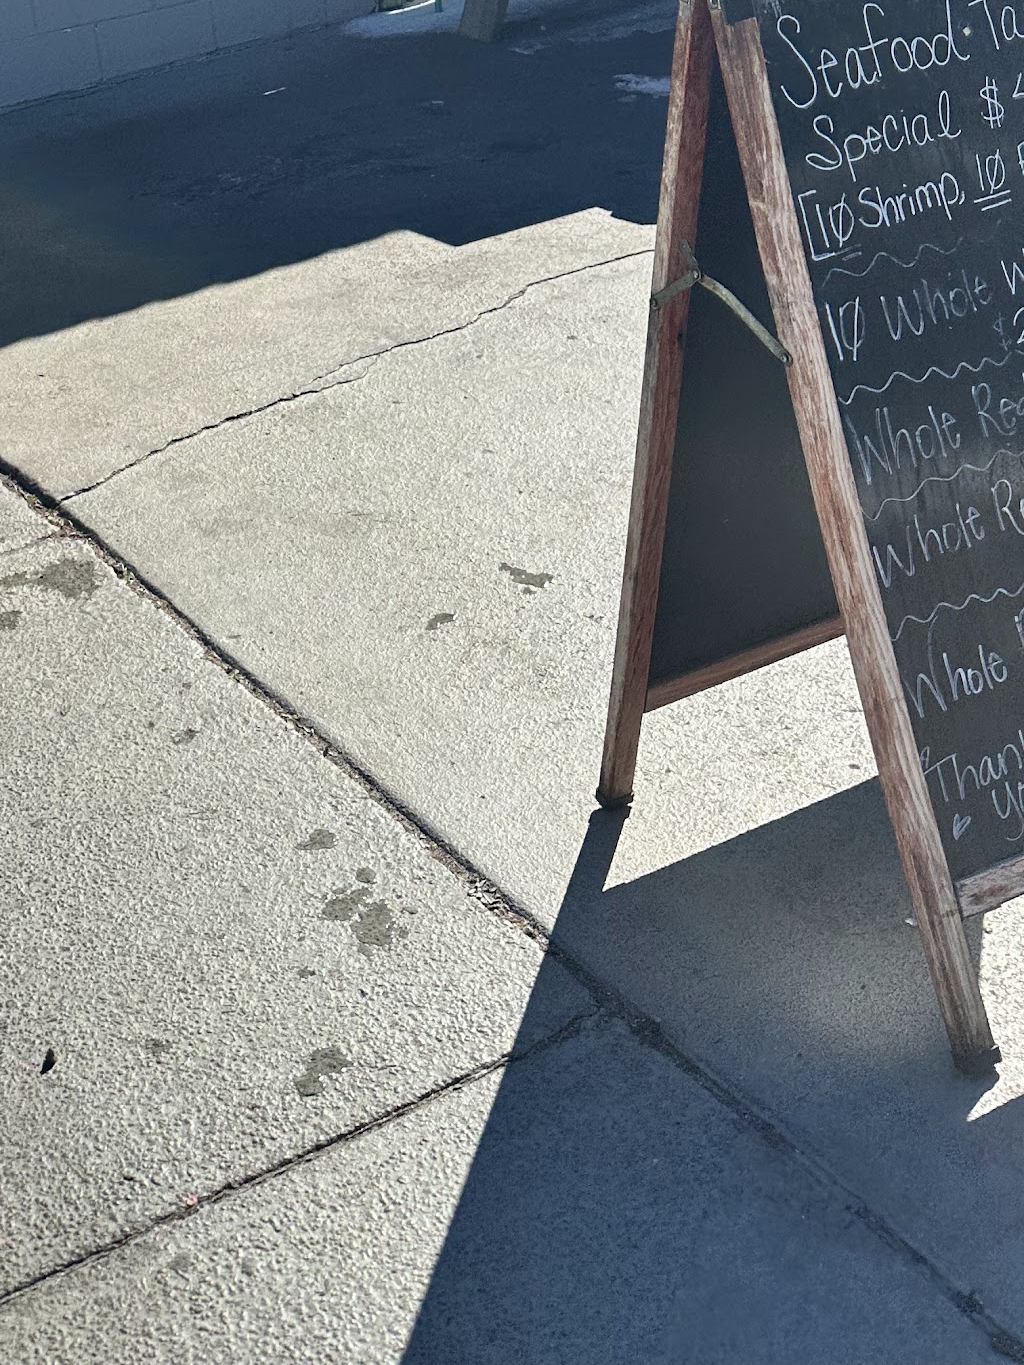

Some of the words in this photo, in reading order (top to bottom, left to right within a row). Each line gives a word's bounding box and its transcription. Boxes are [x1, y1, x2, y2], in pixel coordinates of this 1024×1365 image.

[805, 90, 963, 182] Special
[879, 269, 993, 341] Whole
[843, 405, 961, 485] Whole
[972, 380, 1024, 438] Re
[872, 502, 985, 588] Whole
[902, 629, 1008, 719] Whole
